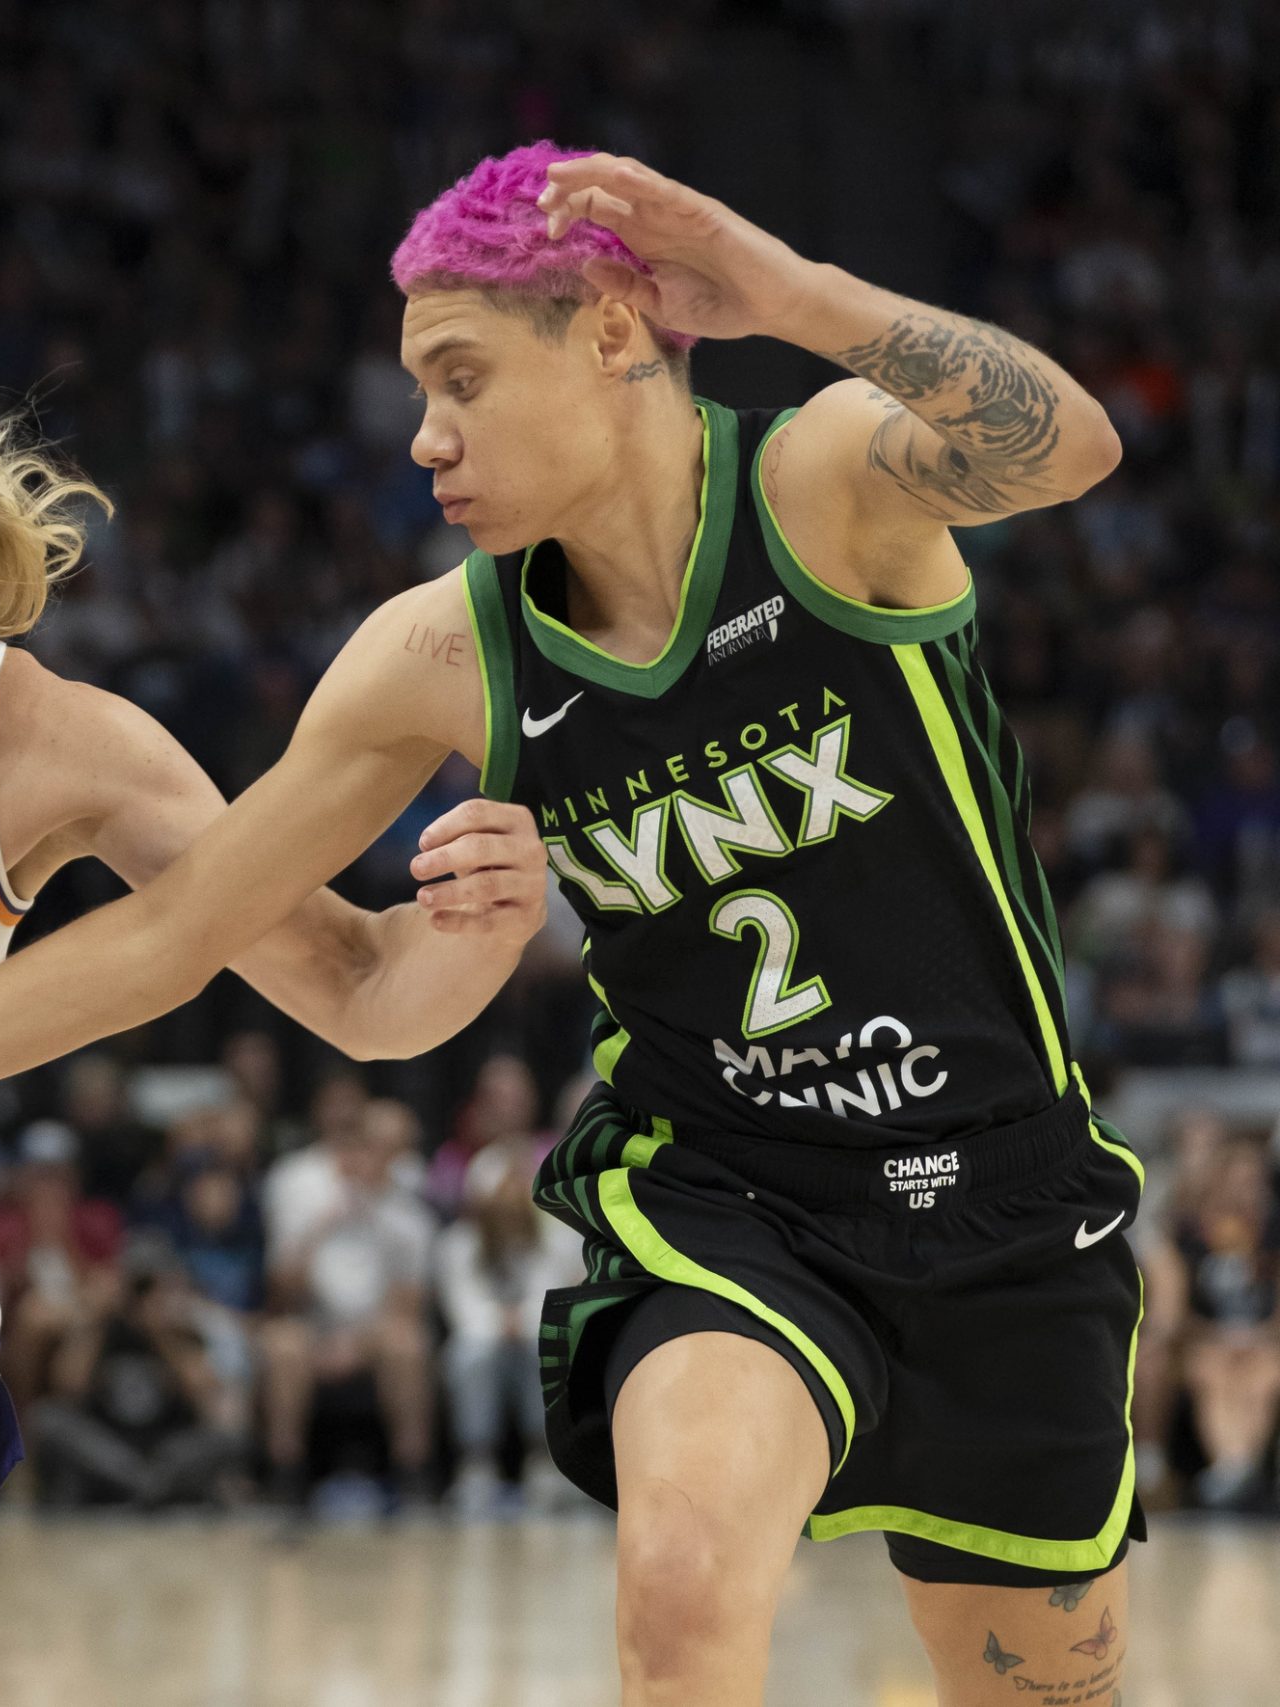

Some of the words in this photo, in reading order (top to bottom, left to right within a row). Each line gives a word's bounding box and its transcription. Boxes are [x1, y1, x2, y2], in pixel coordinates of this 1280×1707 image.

[404, 623, 466, 666] LIVE
[707, 595, 785, 653] FEDERATED
[542, 686, 847, 829] MINNESOTA
[543, 713, 896, 915] LYNX
[708, 888, 833, 1040] 2
[883, 1150, 960, 1178] CHANGE
[889, 1179, 929, 1192] STARTS
[930, 1174, 956, 1188] WITH
[909, 1190, 936, 1209] US
